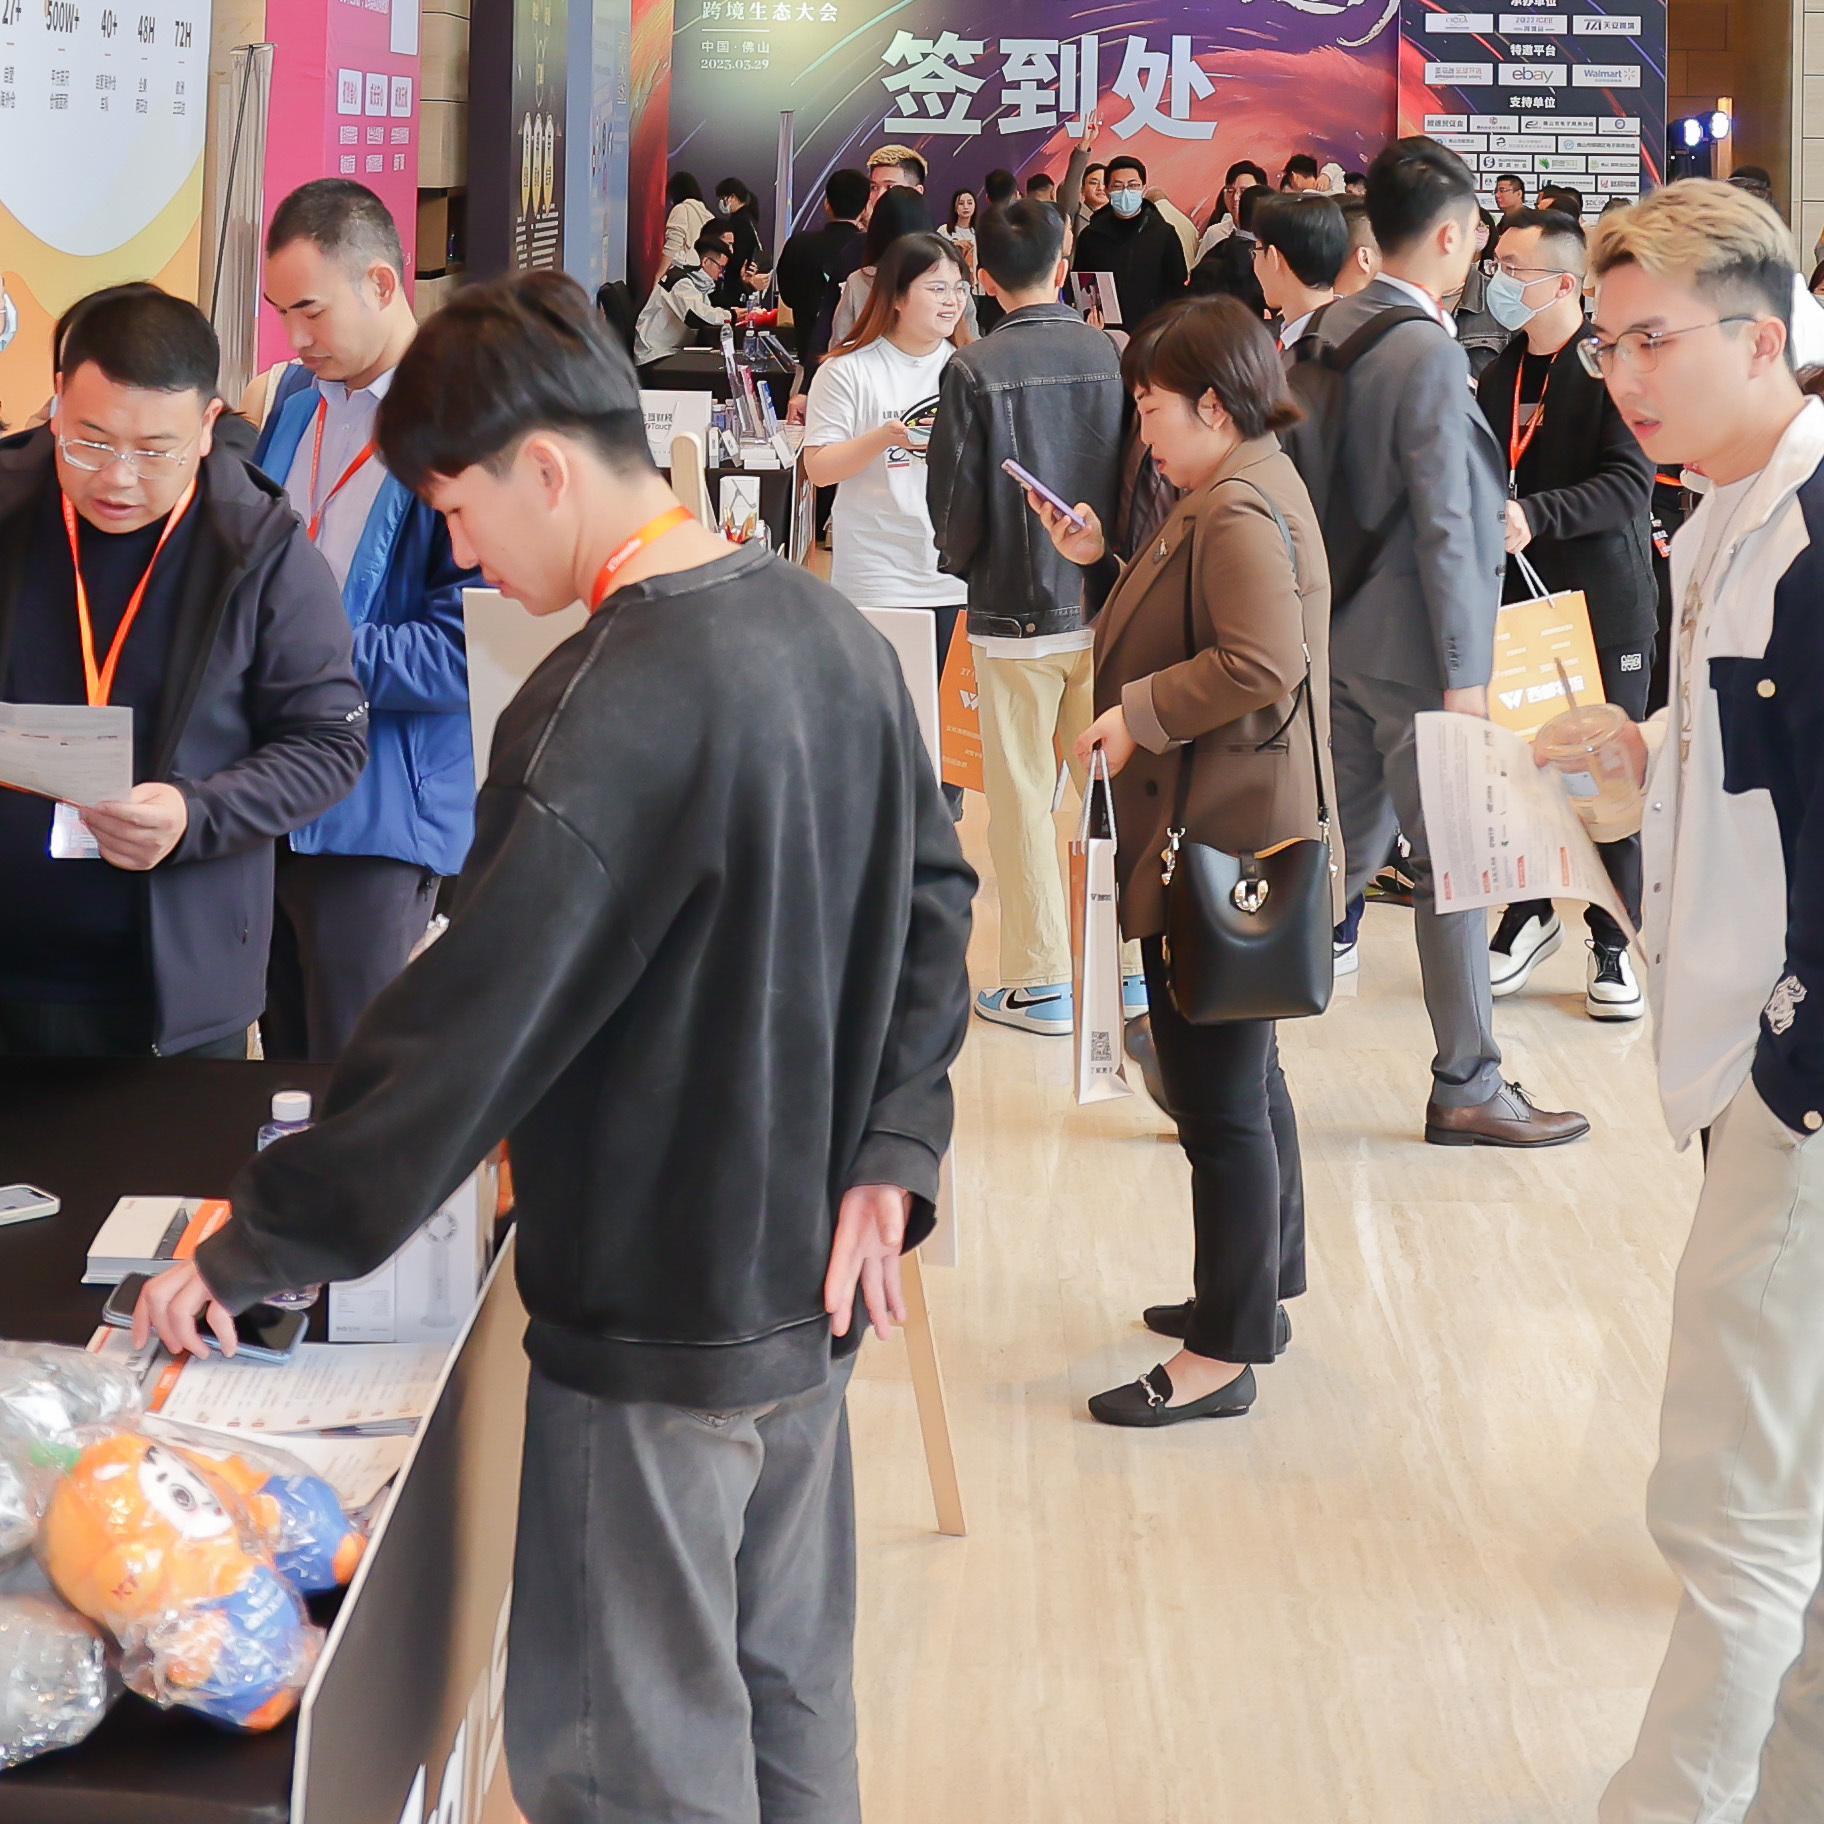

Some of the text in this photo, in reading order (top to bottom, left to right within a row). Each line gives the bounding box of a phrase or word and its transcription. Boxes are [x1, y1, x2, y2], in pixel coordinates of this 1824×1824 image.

[46, 0, 80, 33] 500W+
[701, 1, 839, 23] 跨境生态大会
[101, 9, 118, 38] 40+
[137, 15, 156, 44] 48H
[174, 20, 192, 48] 72H
[1510, 43, 1556, 56] 特邀平台
[700, 58, 770, 70] 2023.03.29
[1512, 67, 1554, 83] ebay
[1583, 68, 1622, 78] Walmart
[880, 29, 1219, 141] 签到处
[1509, 96, 1556, 108] 支持单位
